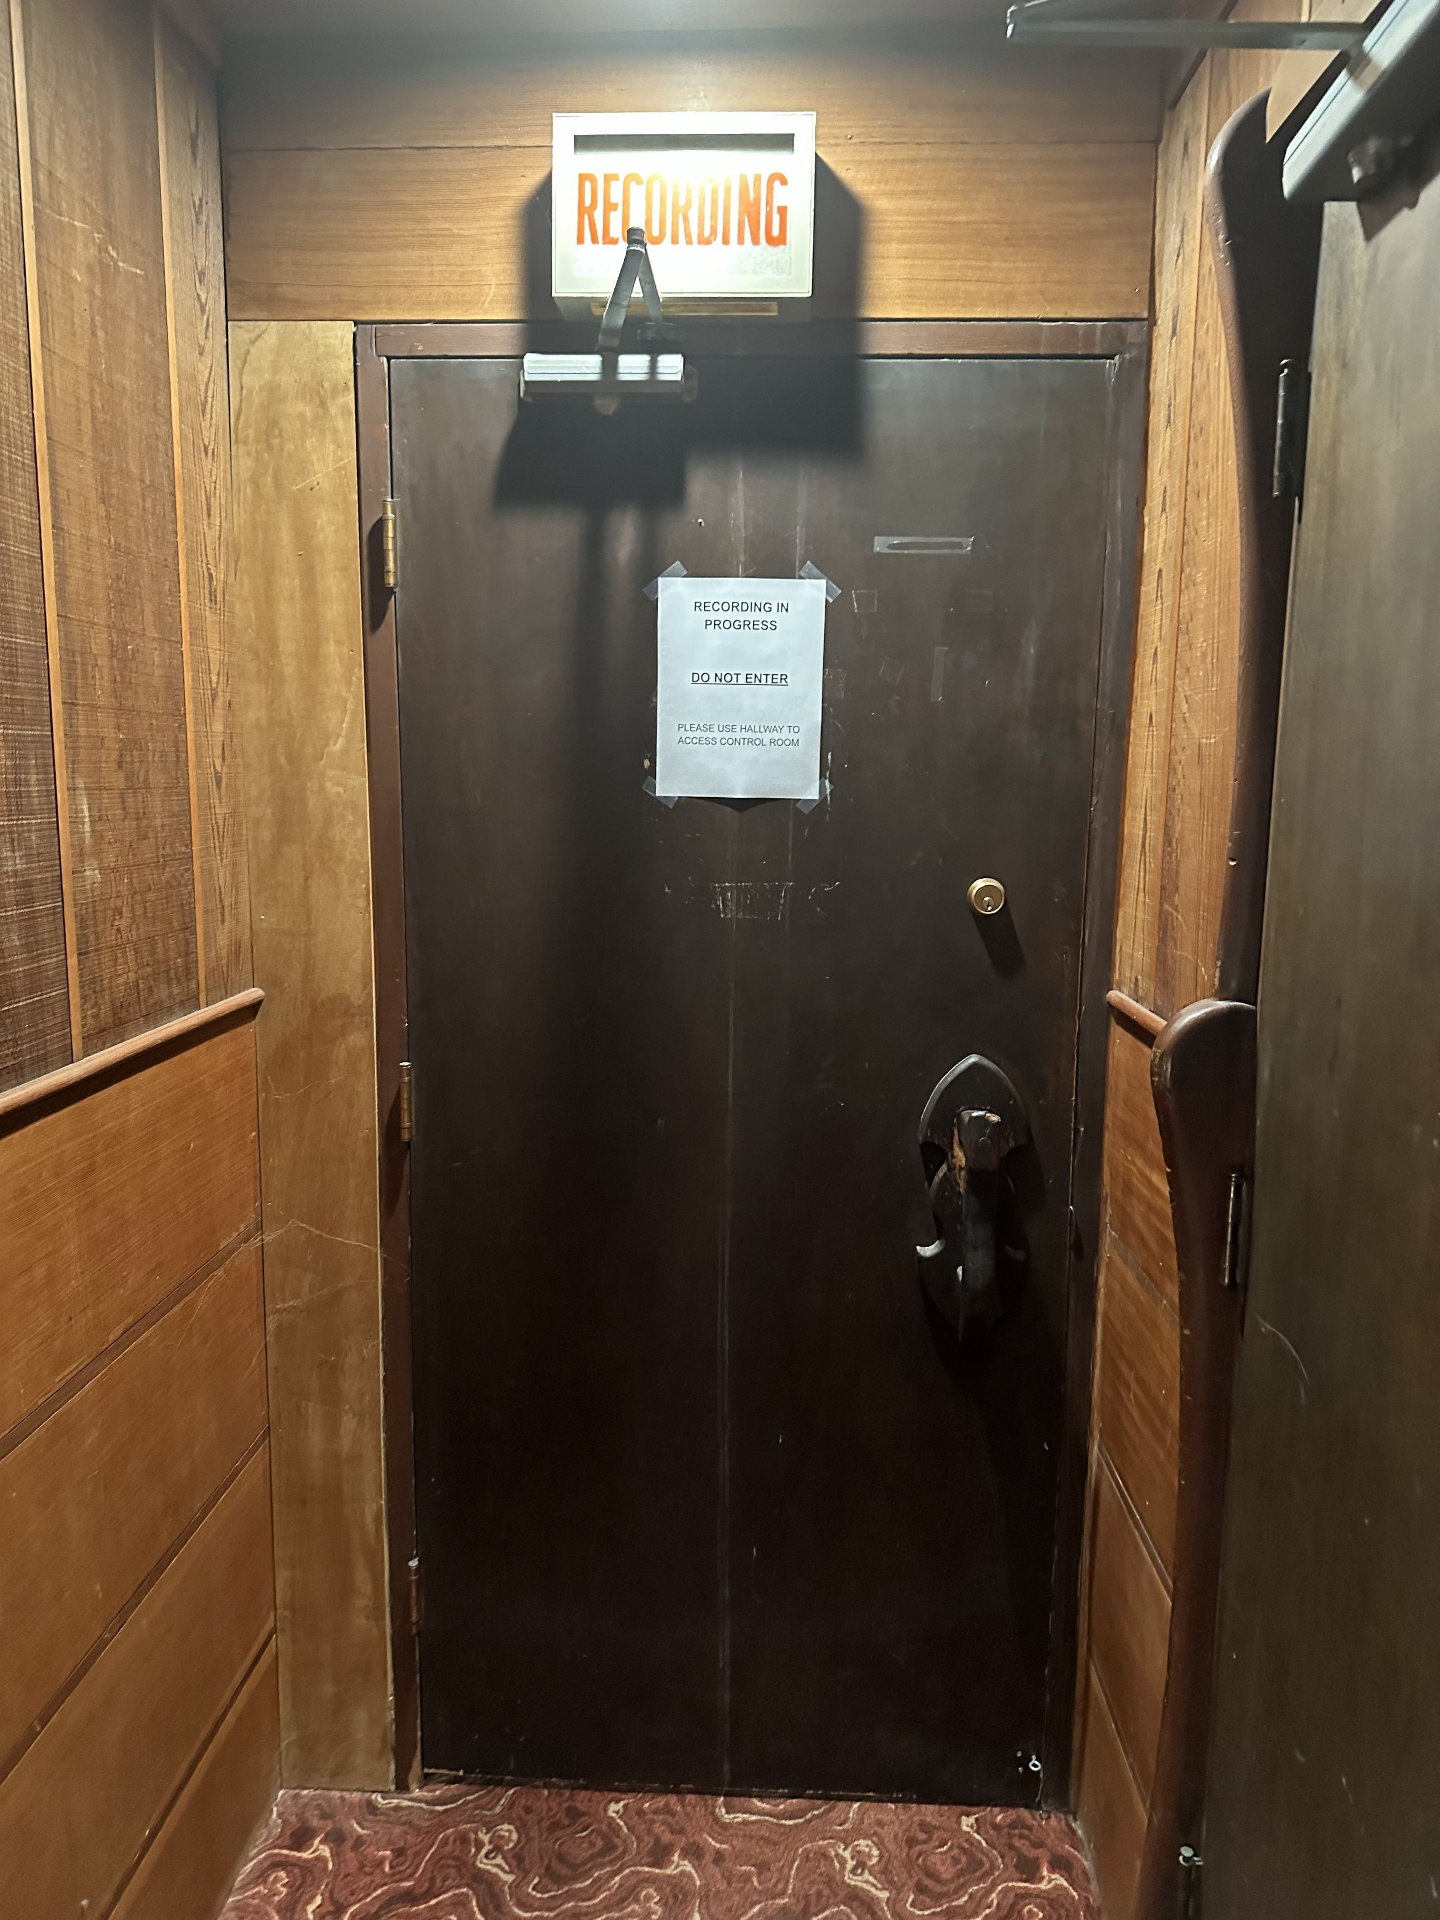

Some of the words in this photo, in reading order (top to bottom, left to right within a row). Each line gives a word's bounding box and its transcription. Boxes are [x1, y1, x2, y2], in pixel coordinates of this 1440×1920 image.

[576, 172, 788, 246] RECORDING
[693, 601, 773, 613] RECORDING
[776, 602, 789, 613] IN
[704, 619, 778, 631] PROGRESS
[691, 672, 710, 683] DO
[714, 673, 741, 684] NOT
[745, 673, 788, 684] ENTER
[677, 723, 715, 733] PLEASE
[717, 724, 737, 733] USE
[740, 724, 785, 734] HALLWAY
[787, 725, 800, 734] TO
[677, 736, 717, 746] ACCESS
[719, 737, 767, 746] CONTROL
[769, 738, 800, 747] ROOM
